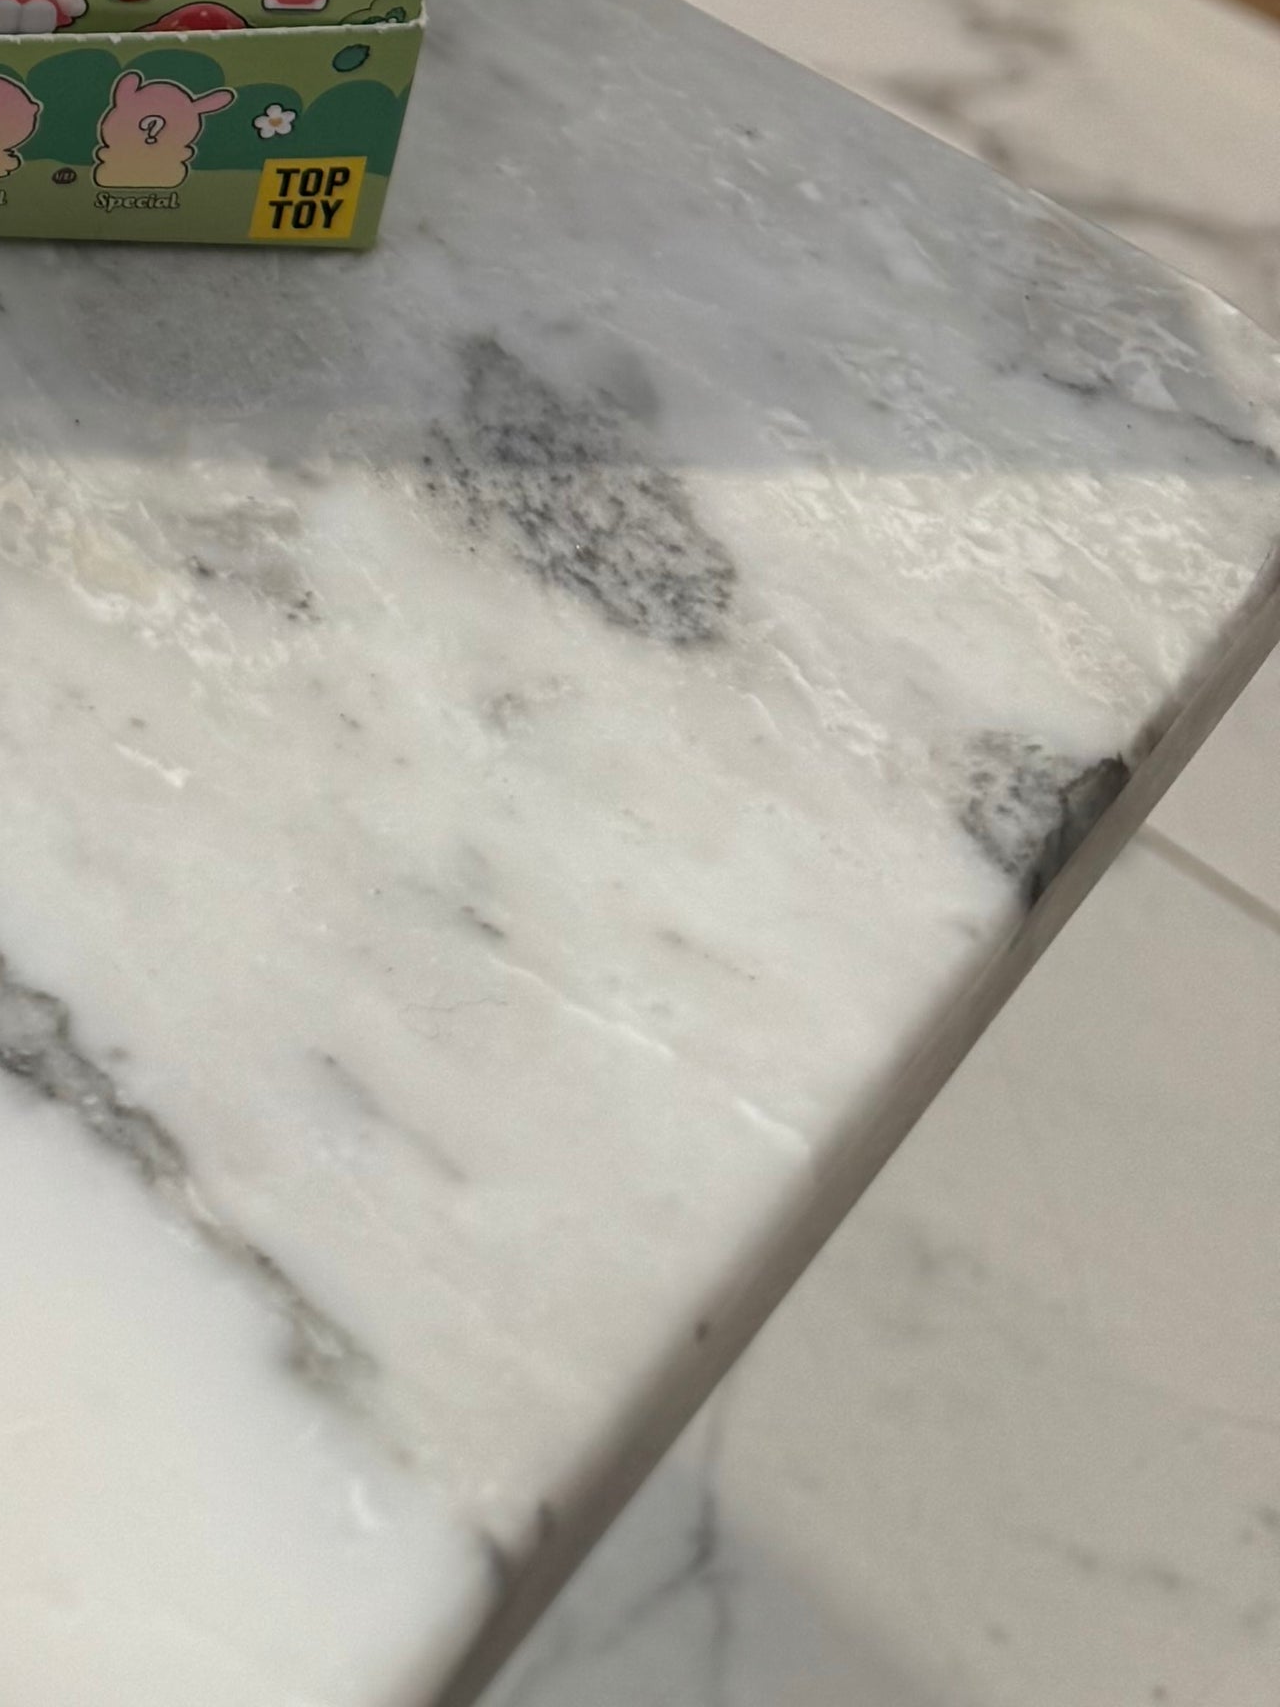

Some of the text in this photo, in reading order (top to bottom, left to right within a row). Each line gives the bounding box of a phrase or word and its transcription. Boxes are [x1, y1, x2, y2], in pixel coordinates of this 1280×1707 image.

[275, 167, 350, 197] TOP
[94, 191, 180, 213] Special
[268, 199, 344, 229] TOY
